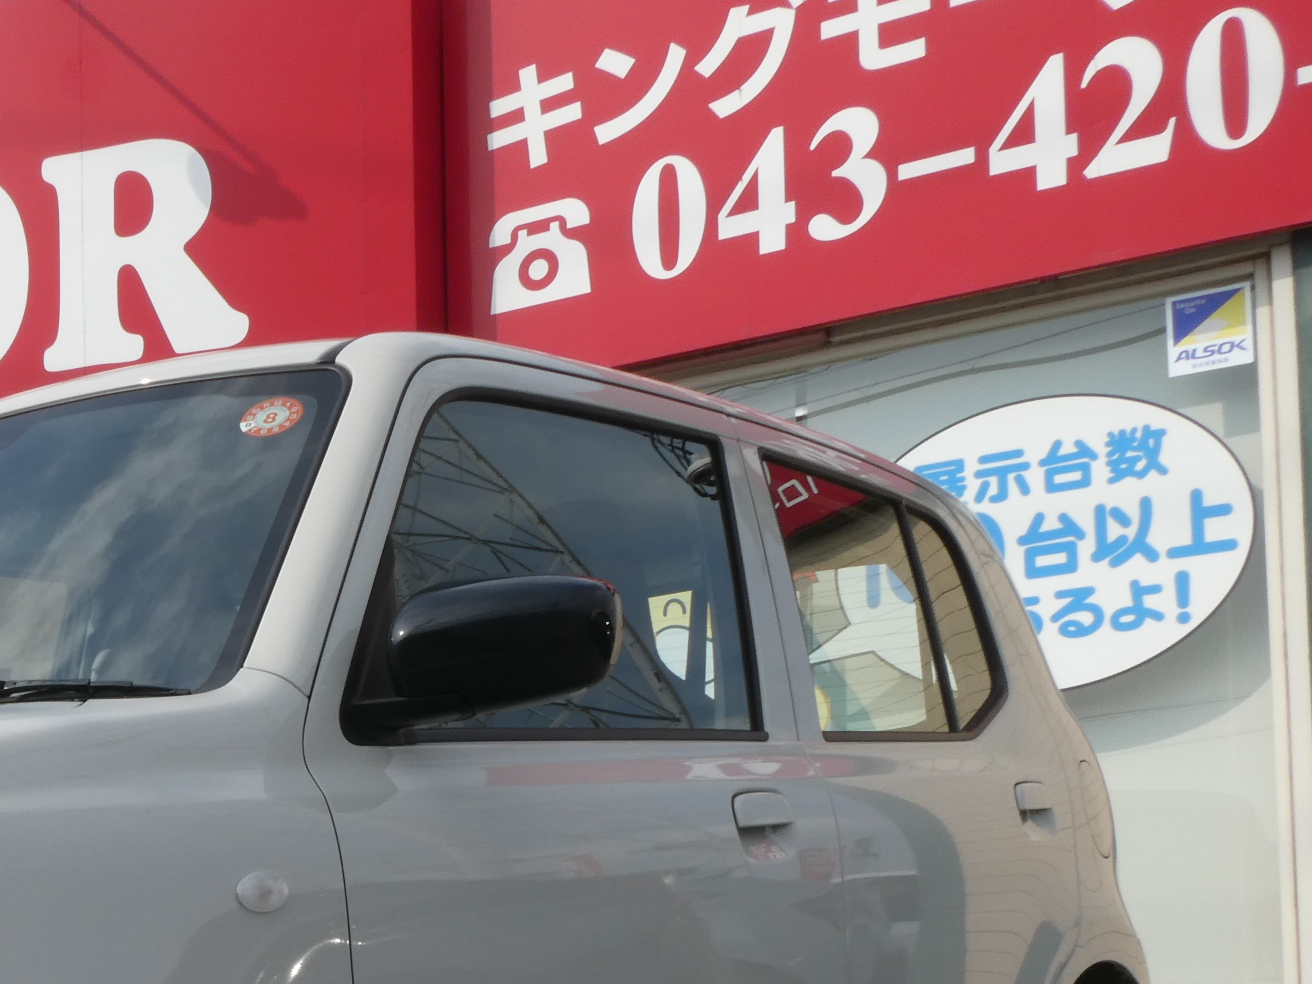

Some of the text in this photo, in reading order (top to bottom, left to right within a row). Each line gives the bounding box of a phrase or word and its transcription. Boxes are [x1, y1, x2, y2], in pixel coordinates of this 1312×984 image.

[487, 0, 1133, 168] キングモ
[632, 7, 1312, 279] 043-420
[1174, 338, 1247, 363] ALSOK
[263, 412, 278, 424] 8
[914, 424, 1169, 504] 展示台数
